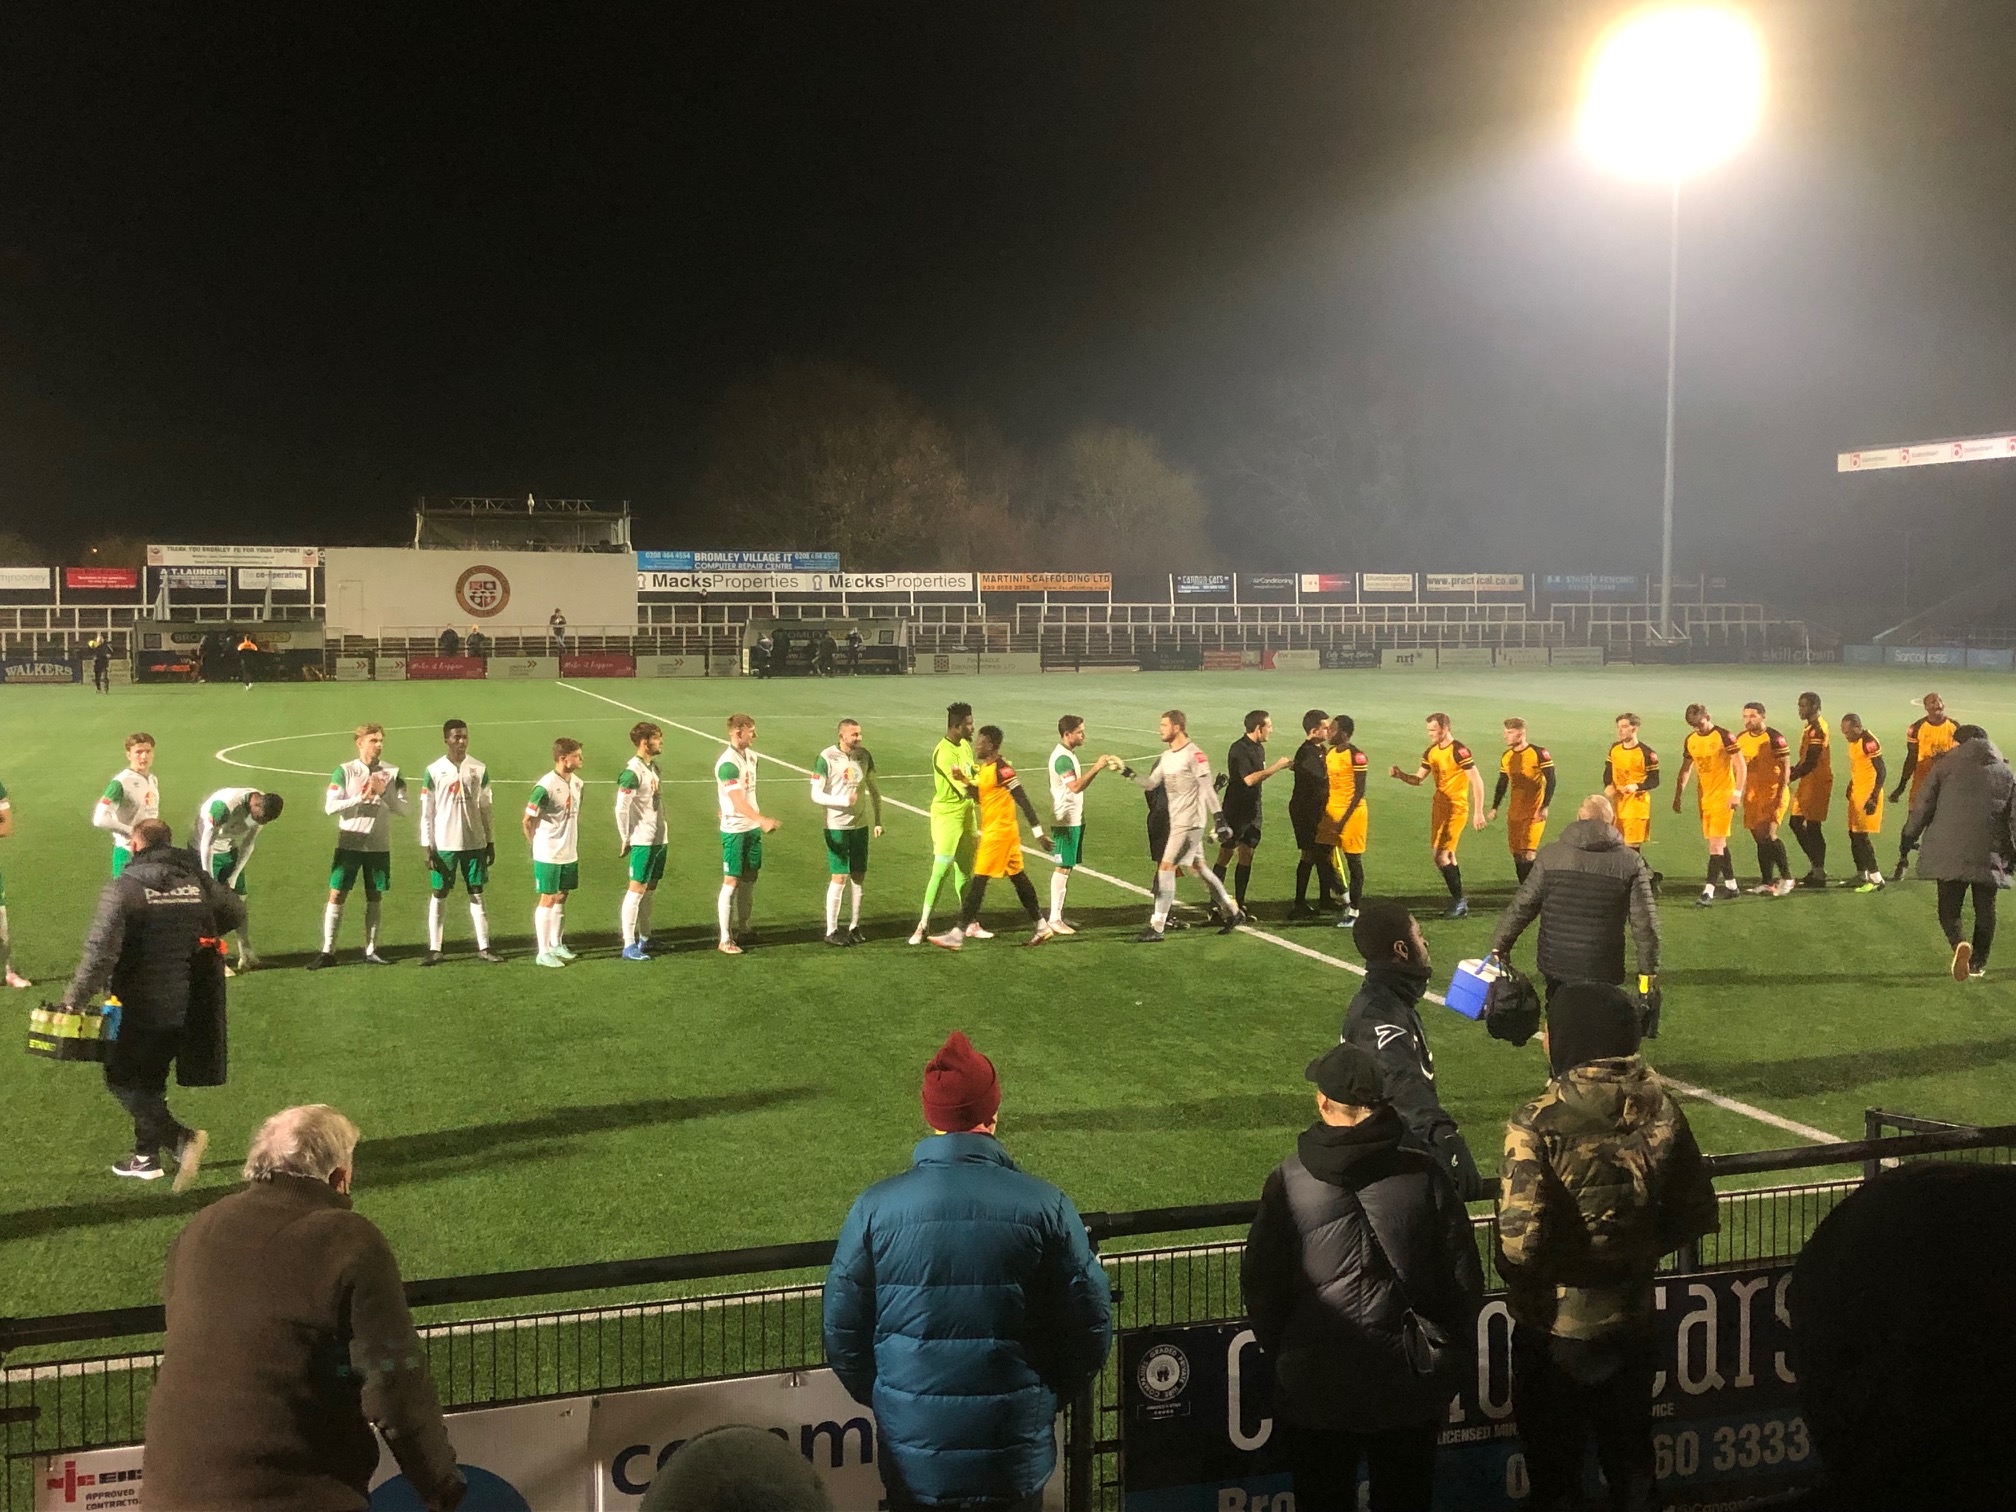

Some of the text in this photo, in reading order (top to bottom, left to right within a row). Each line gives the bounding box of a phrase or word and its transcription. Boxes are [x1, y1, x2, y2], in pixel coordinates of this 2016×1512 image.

[694, 553, 792, 563] BROMLEY VILLAGE IT
[765, 563, 792, 571] CENTRE
[653, 574, 799, 591] MacksProperties
[829, 575, 966, 591] MacksProperties
[983, 574, 1110, 583] MARTINI SCAFFOLDING LTD
[1427, 575, 1519, 587] www.practical.co.uk
[5, 663, 73, 676] WALKERS
[1437, 1427, 1490, 1445] LICENSED
[1713, 1417, 1811, 1471] 3333
[86, 1488, 135, 1501] APPROVED
[86, 1498, 142, 1511] CONTRACTO
